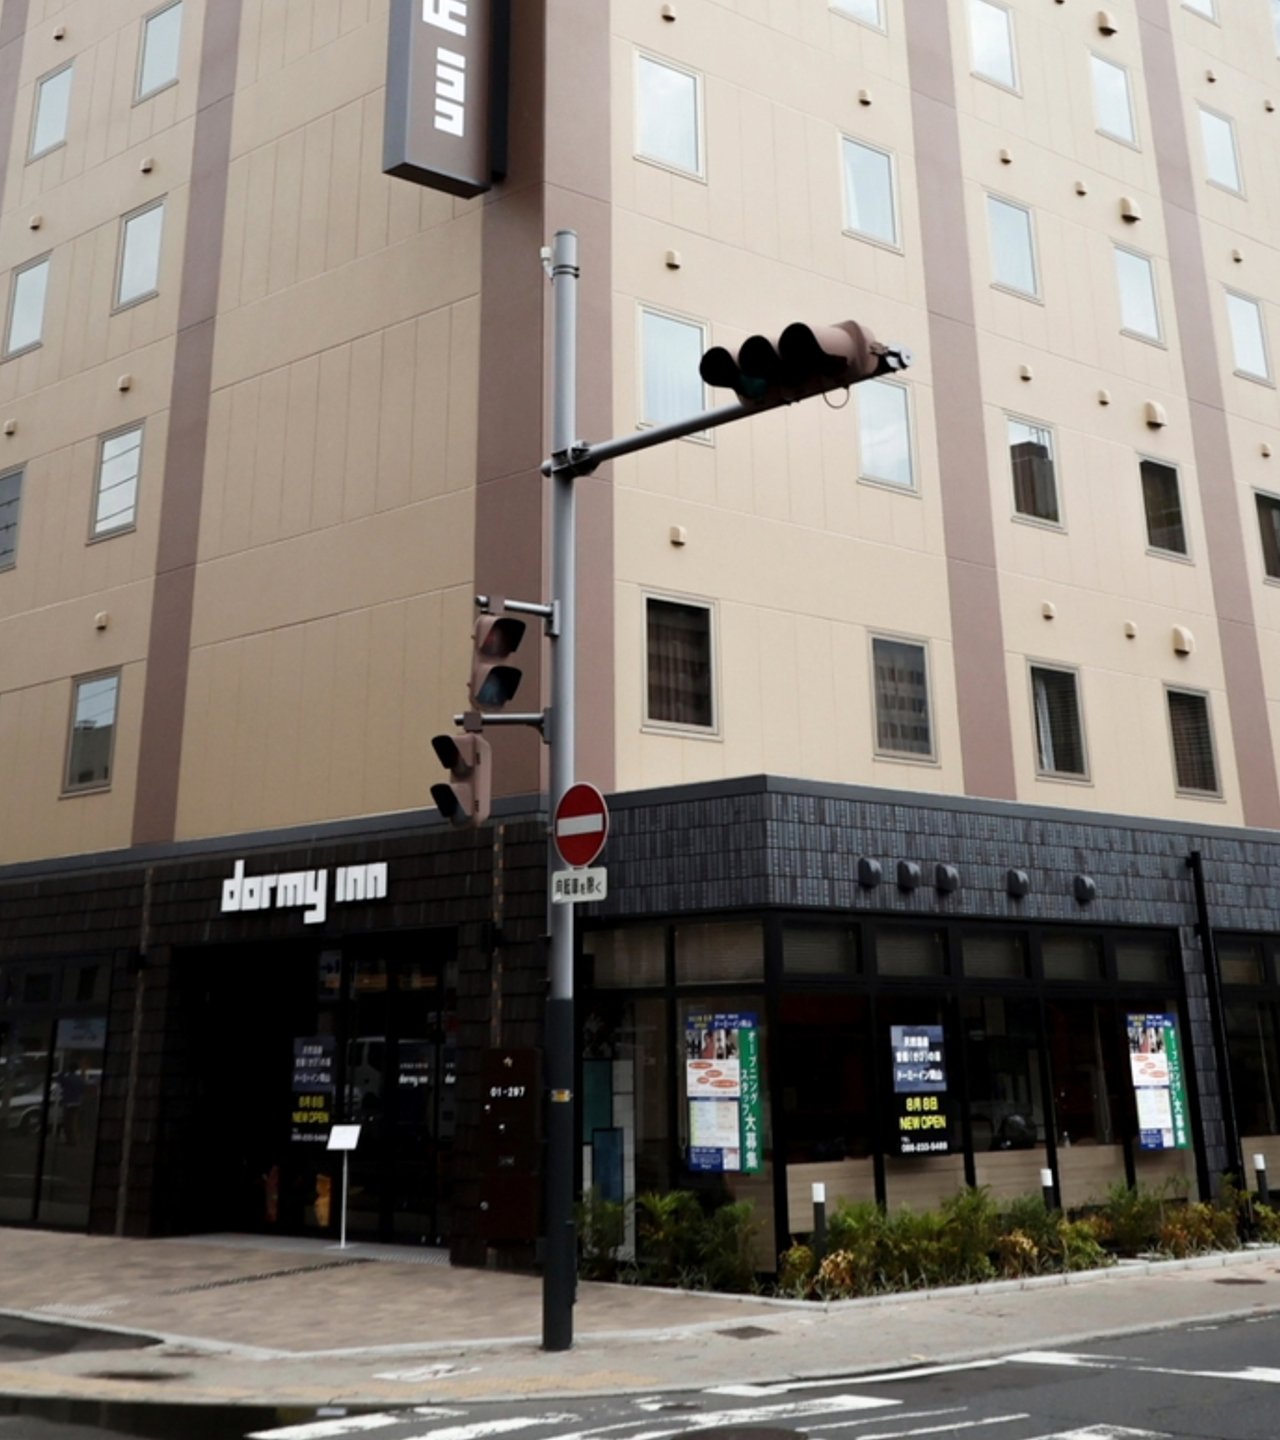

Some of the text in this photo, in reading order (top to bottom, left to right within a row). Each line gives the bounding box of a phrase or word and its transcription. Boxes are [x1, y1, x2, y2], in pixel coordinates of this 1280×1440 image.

[433, 46, 466, 137] inn
[221, 859, 388, 924] dormy inn
[490, 1086, 525, 1097] 01-297
[744, 1113, 759, 1168] 大募集
[899, 1115, 946, 1130] NEW OPEN
